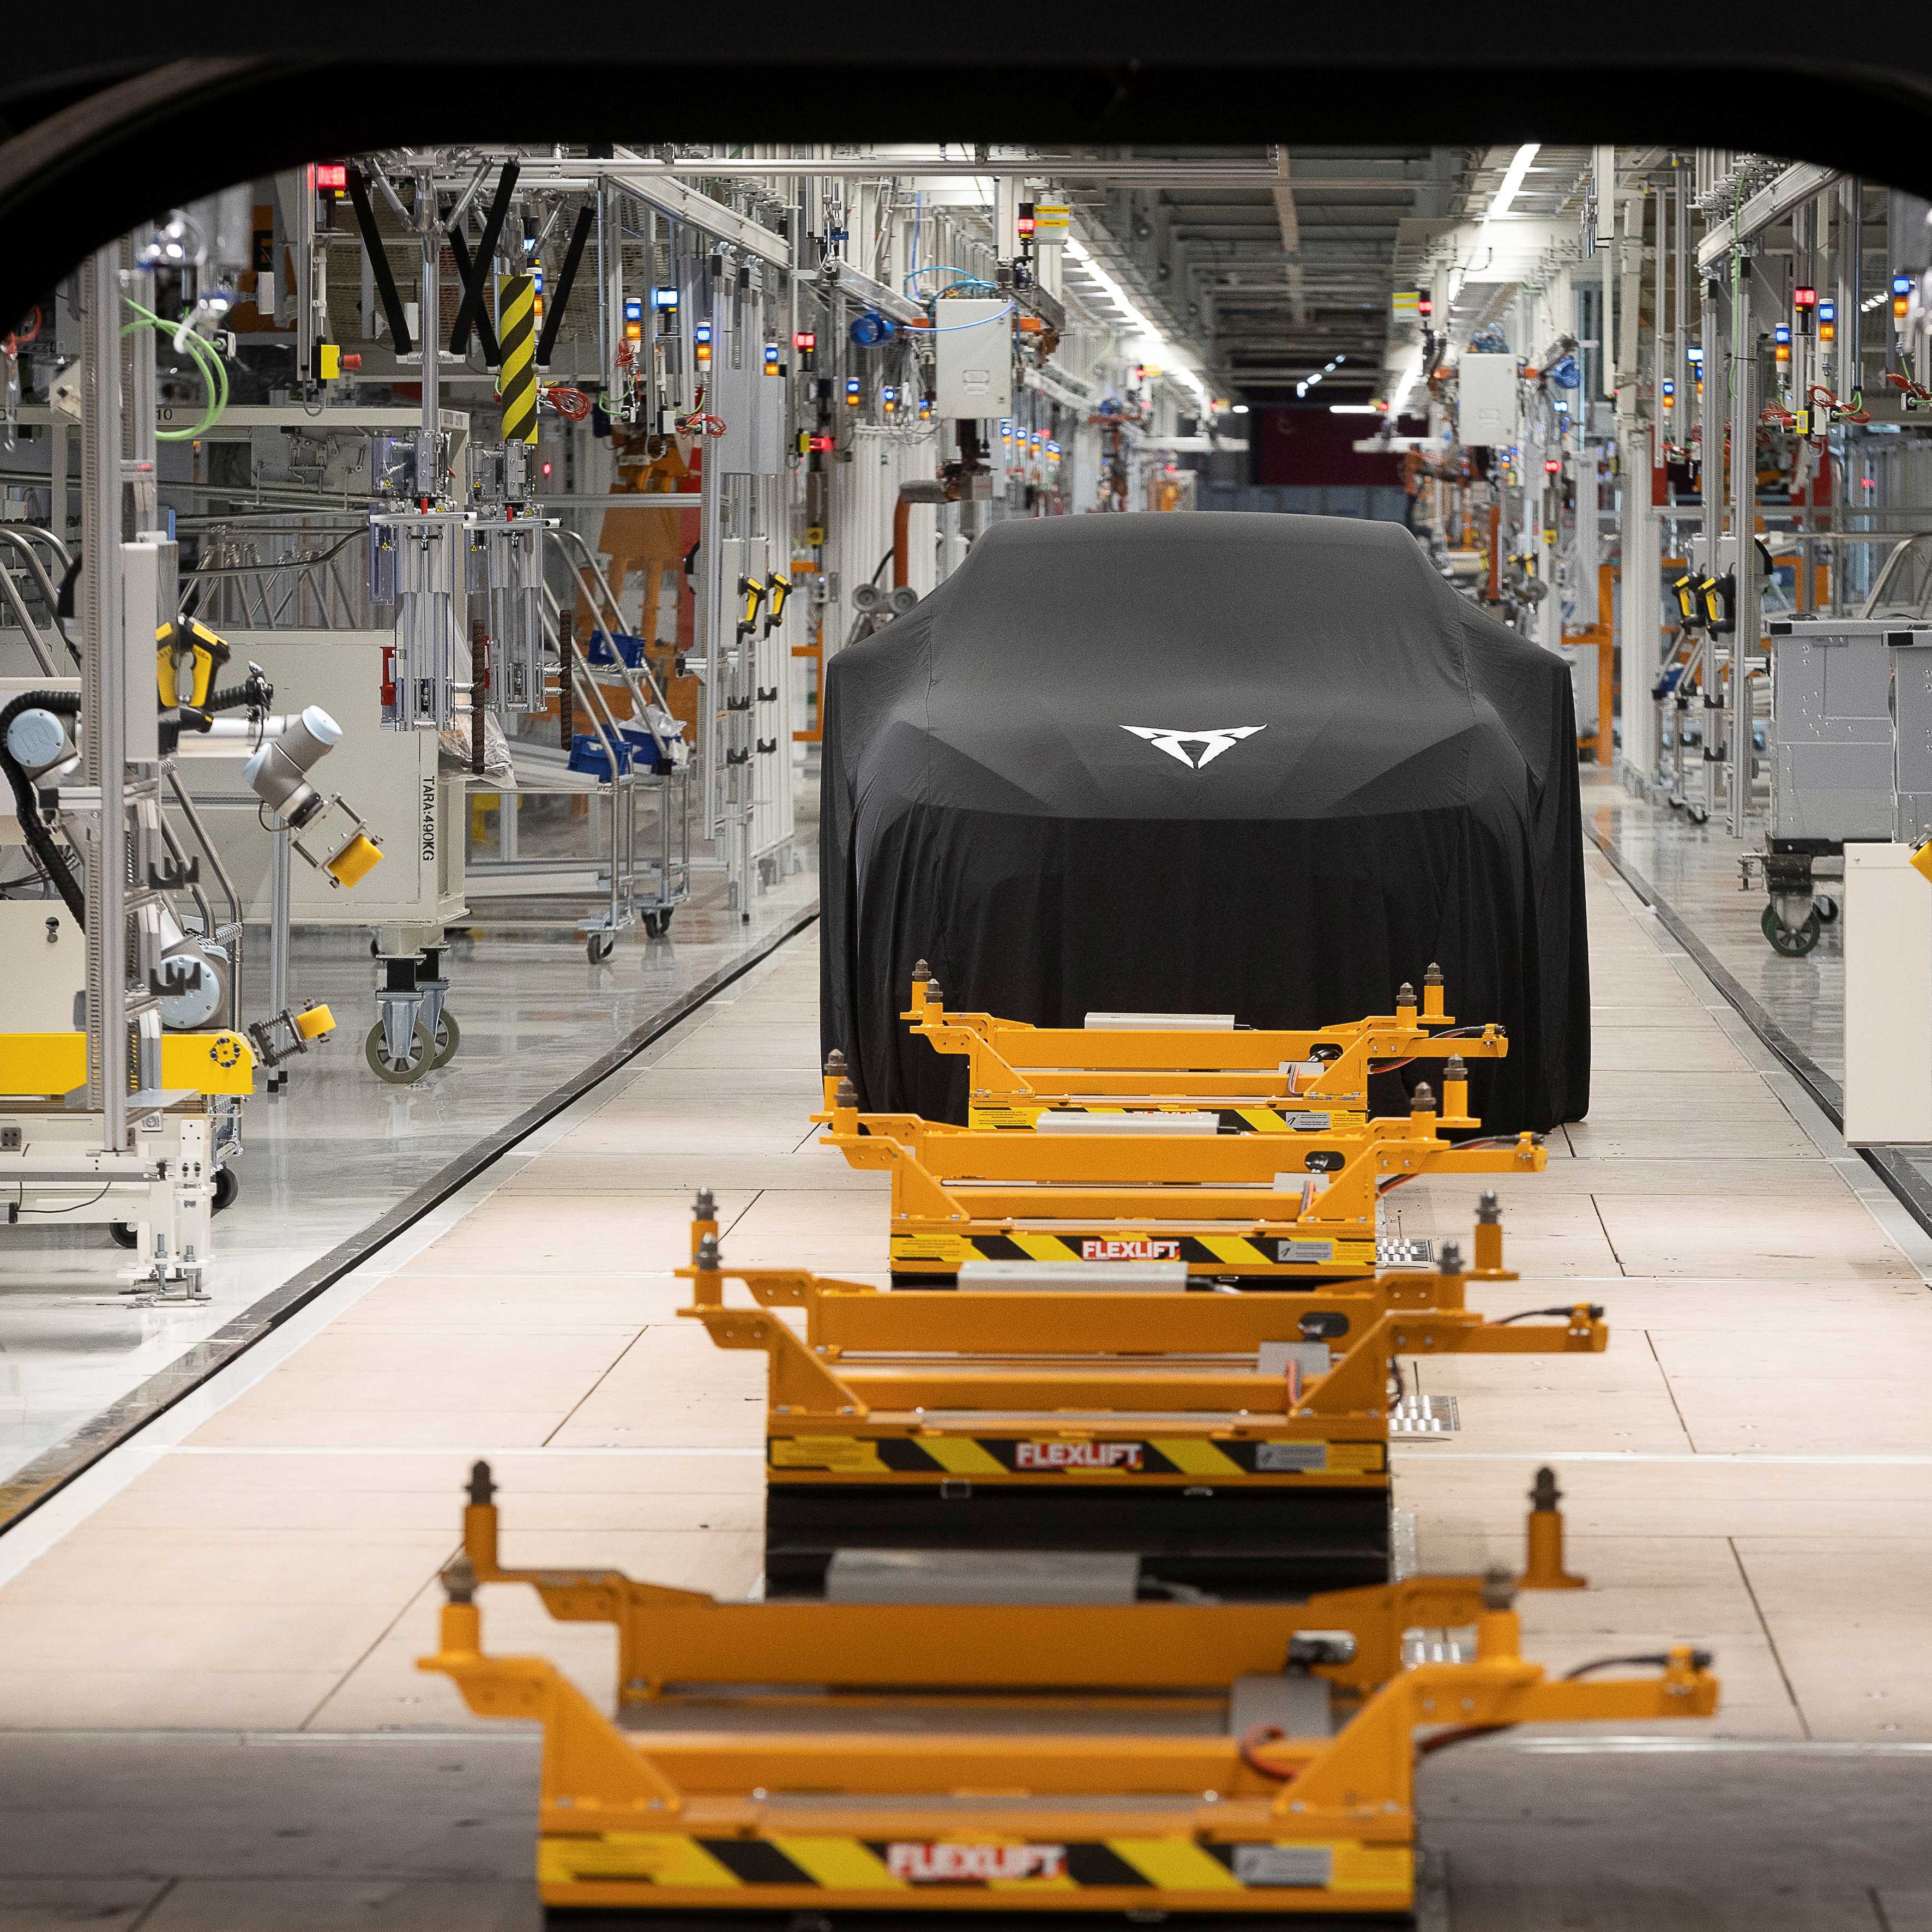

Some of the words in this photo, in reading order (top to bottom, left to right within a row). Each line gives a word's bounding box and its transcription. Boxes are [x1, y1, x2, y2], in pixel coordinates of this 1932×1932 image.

[423, 775, 435, 861] TARA:490KG
[1082, 1241, 1180, 1259] FLEXLIFT
[1016, 1443, 1143, 1467] FLEXLIFT
[888, 1843, 1067, 1877] FLEXLIFT
